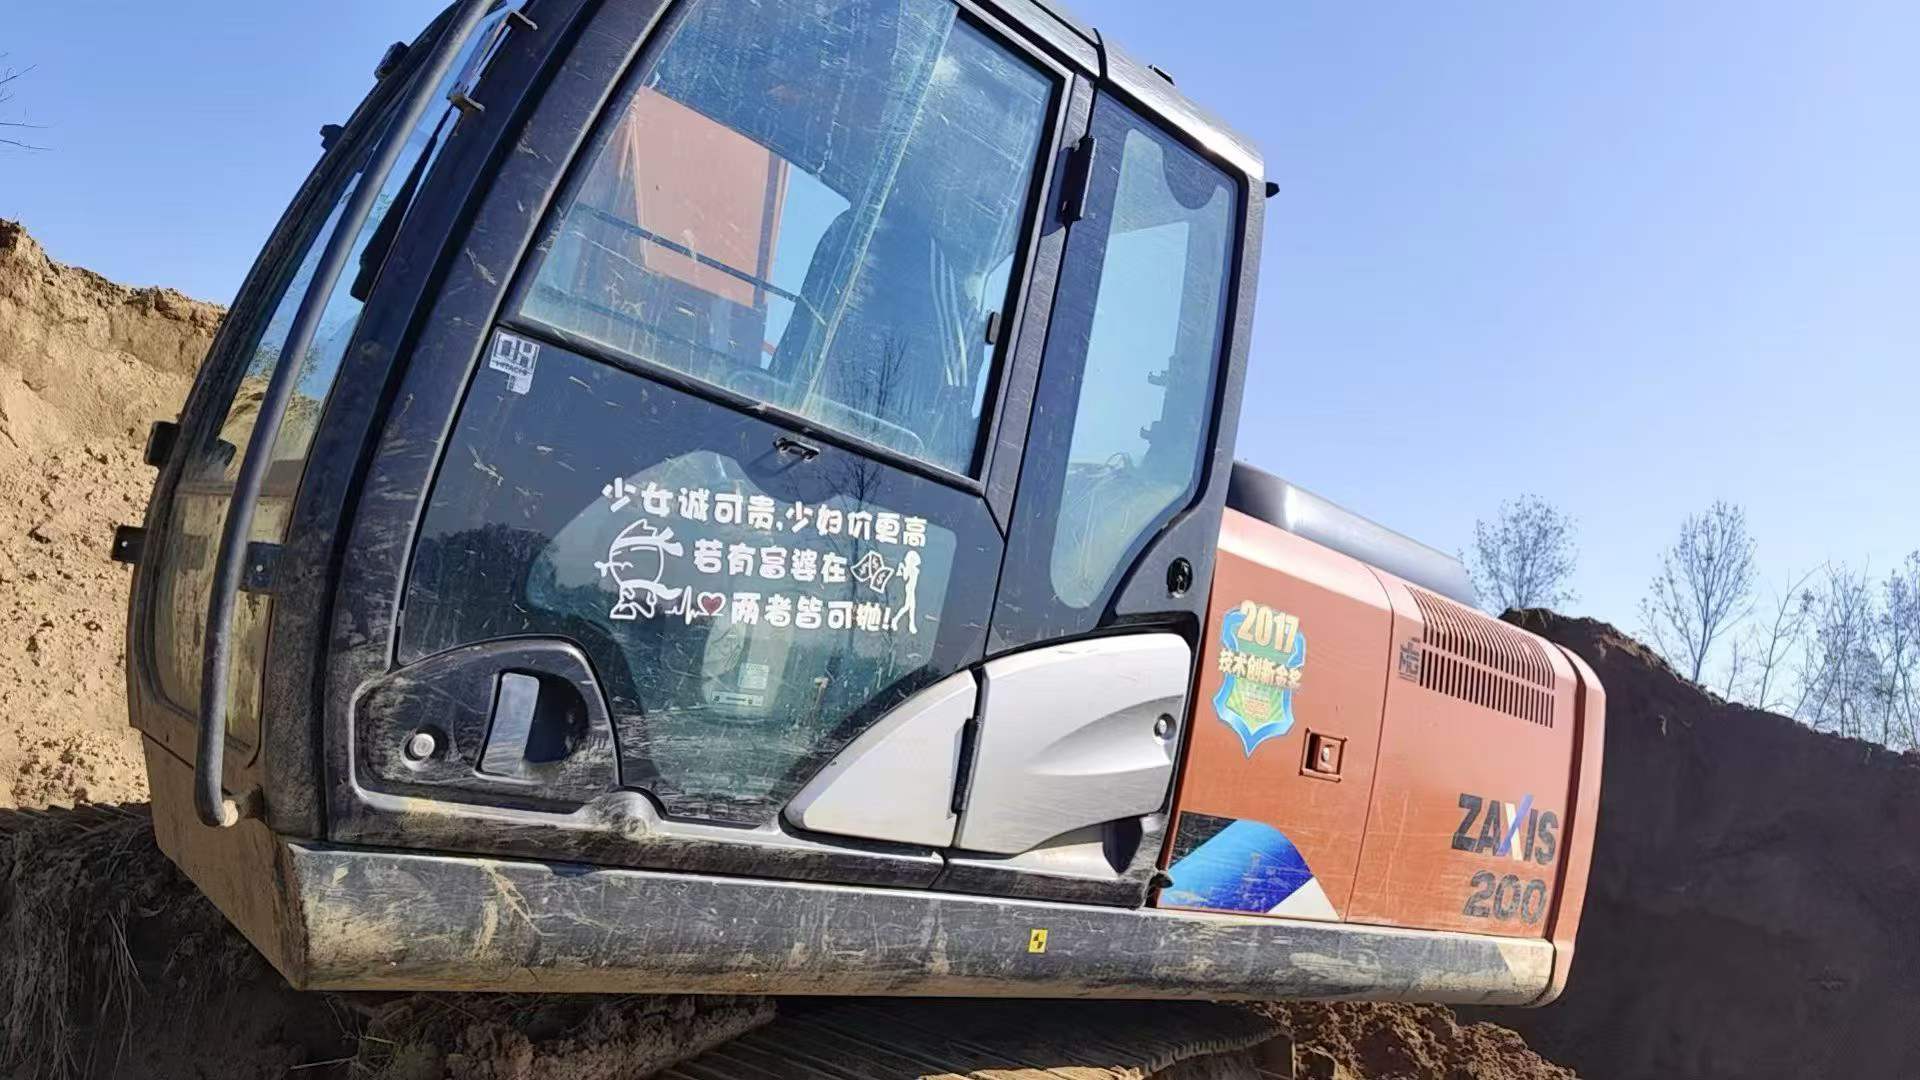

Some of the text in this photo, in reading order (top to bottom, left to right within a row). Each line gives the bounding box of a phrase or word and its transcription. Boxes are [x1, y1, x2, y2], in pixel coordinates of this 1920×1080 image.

[694, 539, 847, 584] 若有富婆在
[1237, 600, 1300, 653] 2017
[1452, 792, 1559, 866] ZAXIS
[1463, 869, 1547, 925] 200
